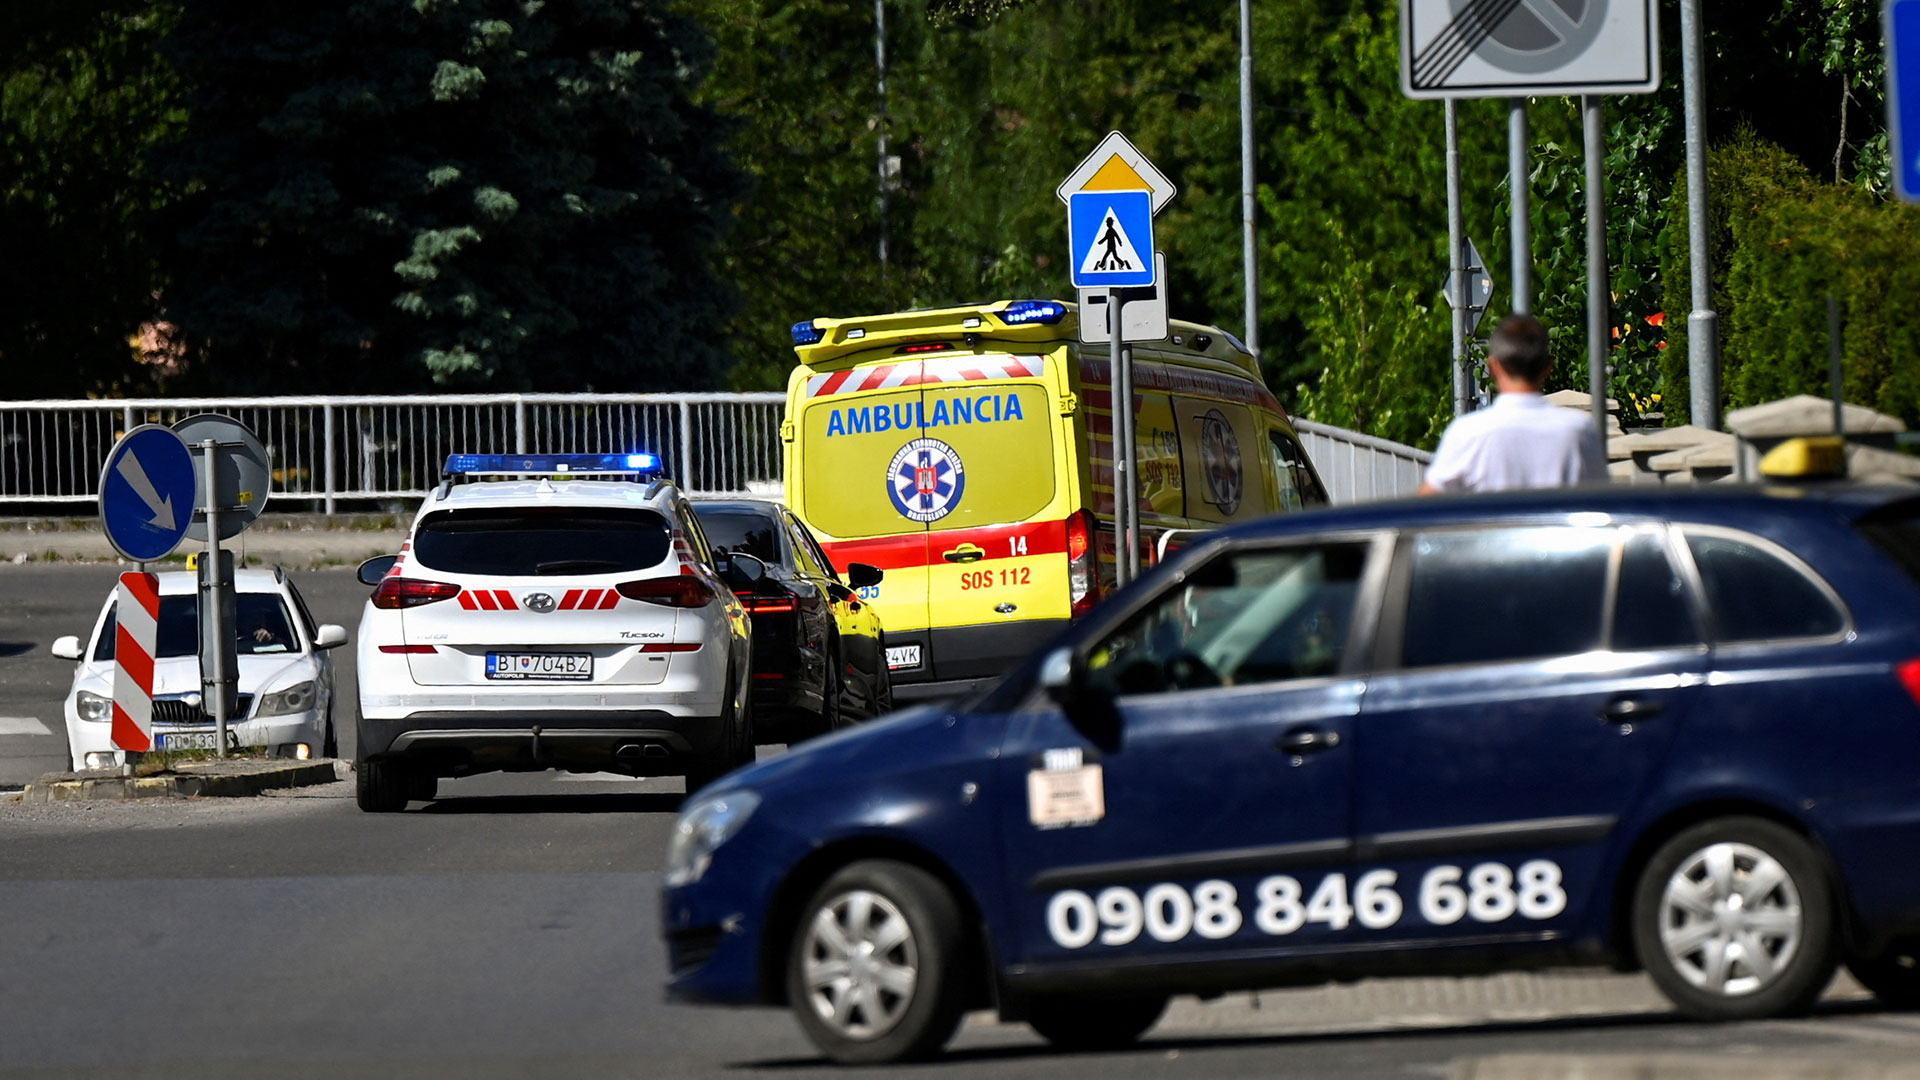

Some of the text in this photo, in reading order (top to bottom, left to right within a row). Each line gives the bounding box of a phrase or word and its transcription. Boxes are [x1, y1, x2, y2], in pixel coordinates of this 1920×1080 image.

[826, 393, 1024, 437] AMBULANCIA
[1009, 535, 1028, 556] 14
[961, 566, 1031, 591] SOS 112
[619, 631, 665, 639] TUCSON
[1047, 859, 1568, 949] 0908 846 688
